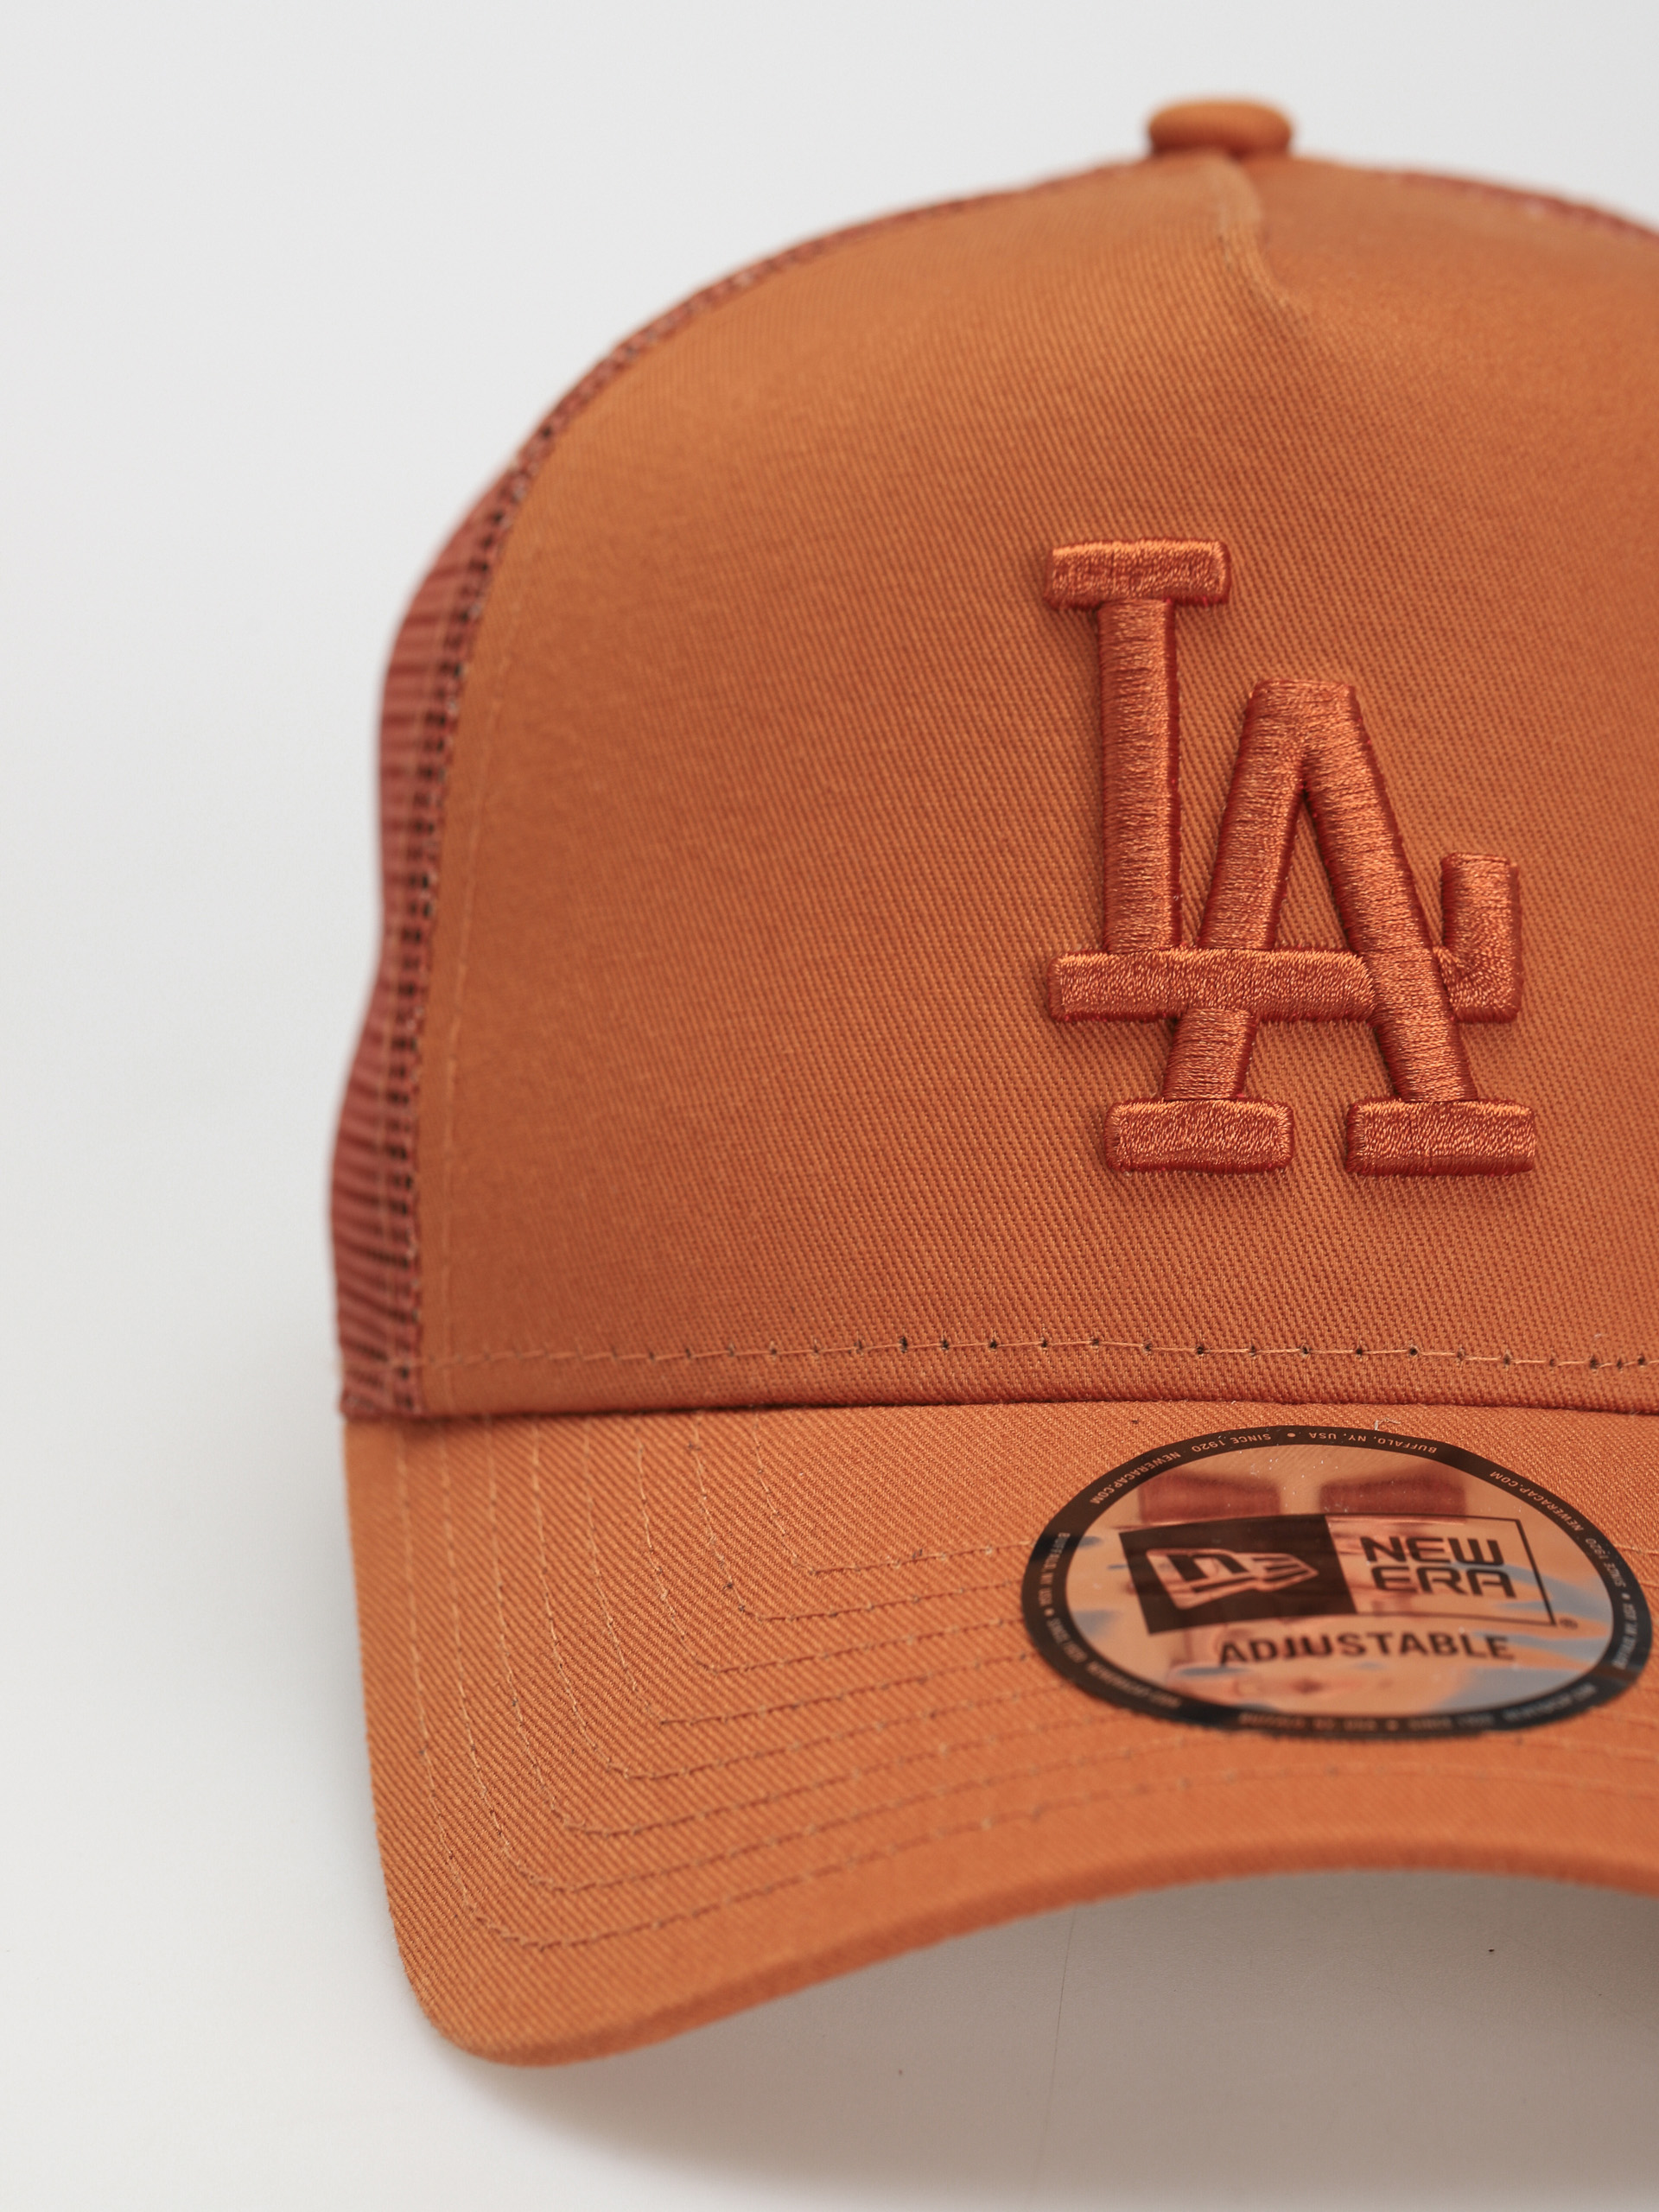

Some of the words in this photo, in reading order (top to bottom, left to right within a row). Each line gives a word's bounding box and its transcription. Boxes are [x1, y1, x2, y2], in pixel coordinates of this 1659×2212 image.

[1046, 537, 1536, 1177] LA
[1191, 1440, 1226, 1453] 1920
[1230, 1433, 1272, 1445] SINCE
[1307, 1431, 1338, 1440] USA
[1090, 1452, 1182, 1504] NEWERACAP.COM
[1358, 1535, 1506, 1567] NEW
[1370, 1565, 1517, 1599] ERA
[1218, 1630, 1516, 1667] ADJUSTABLE
